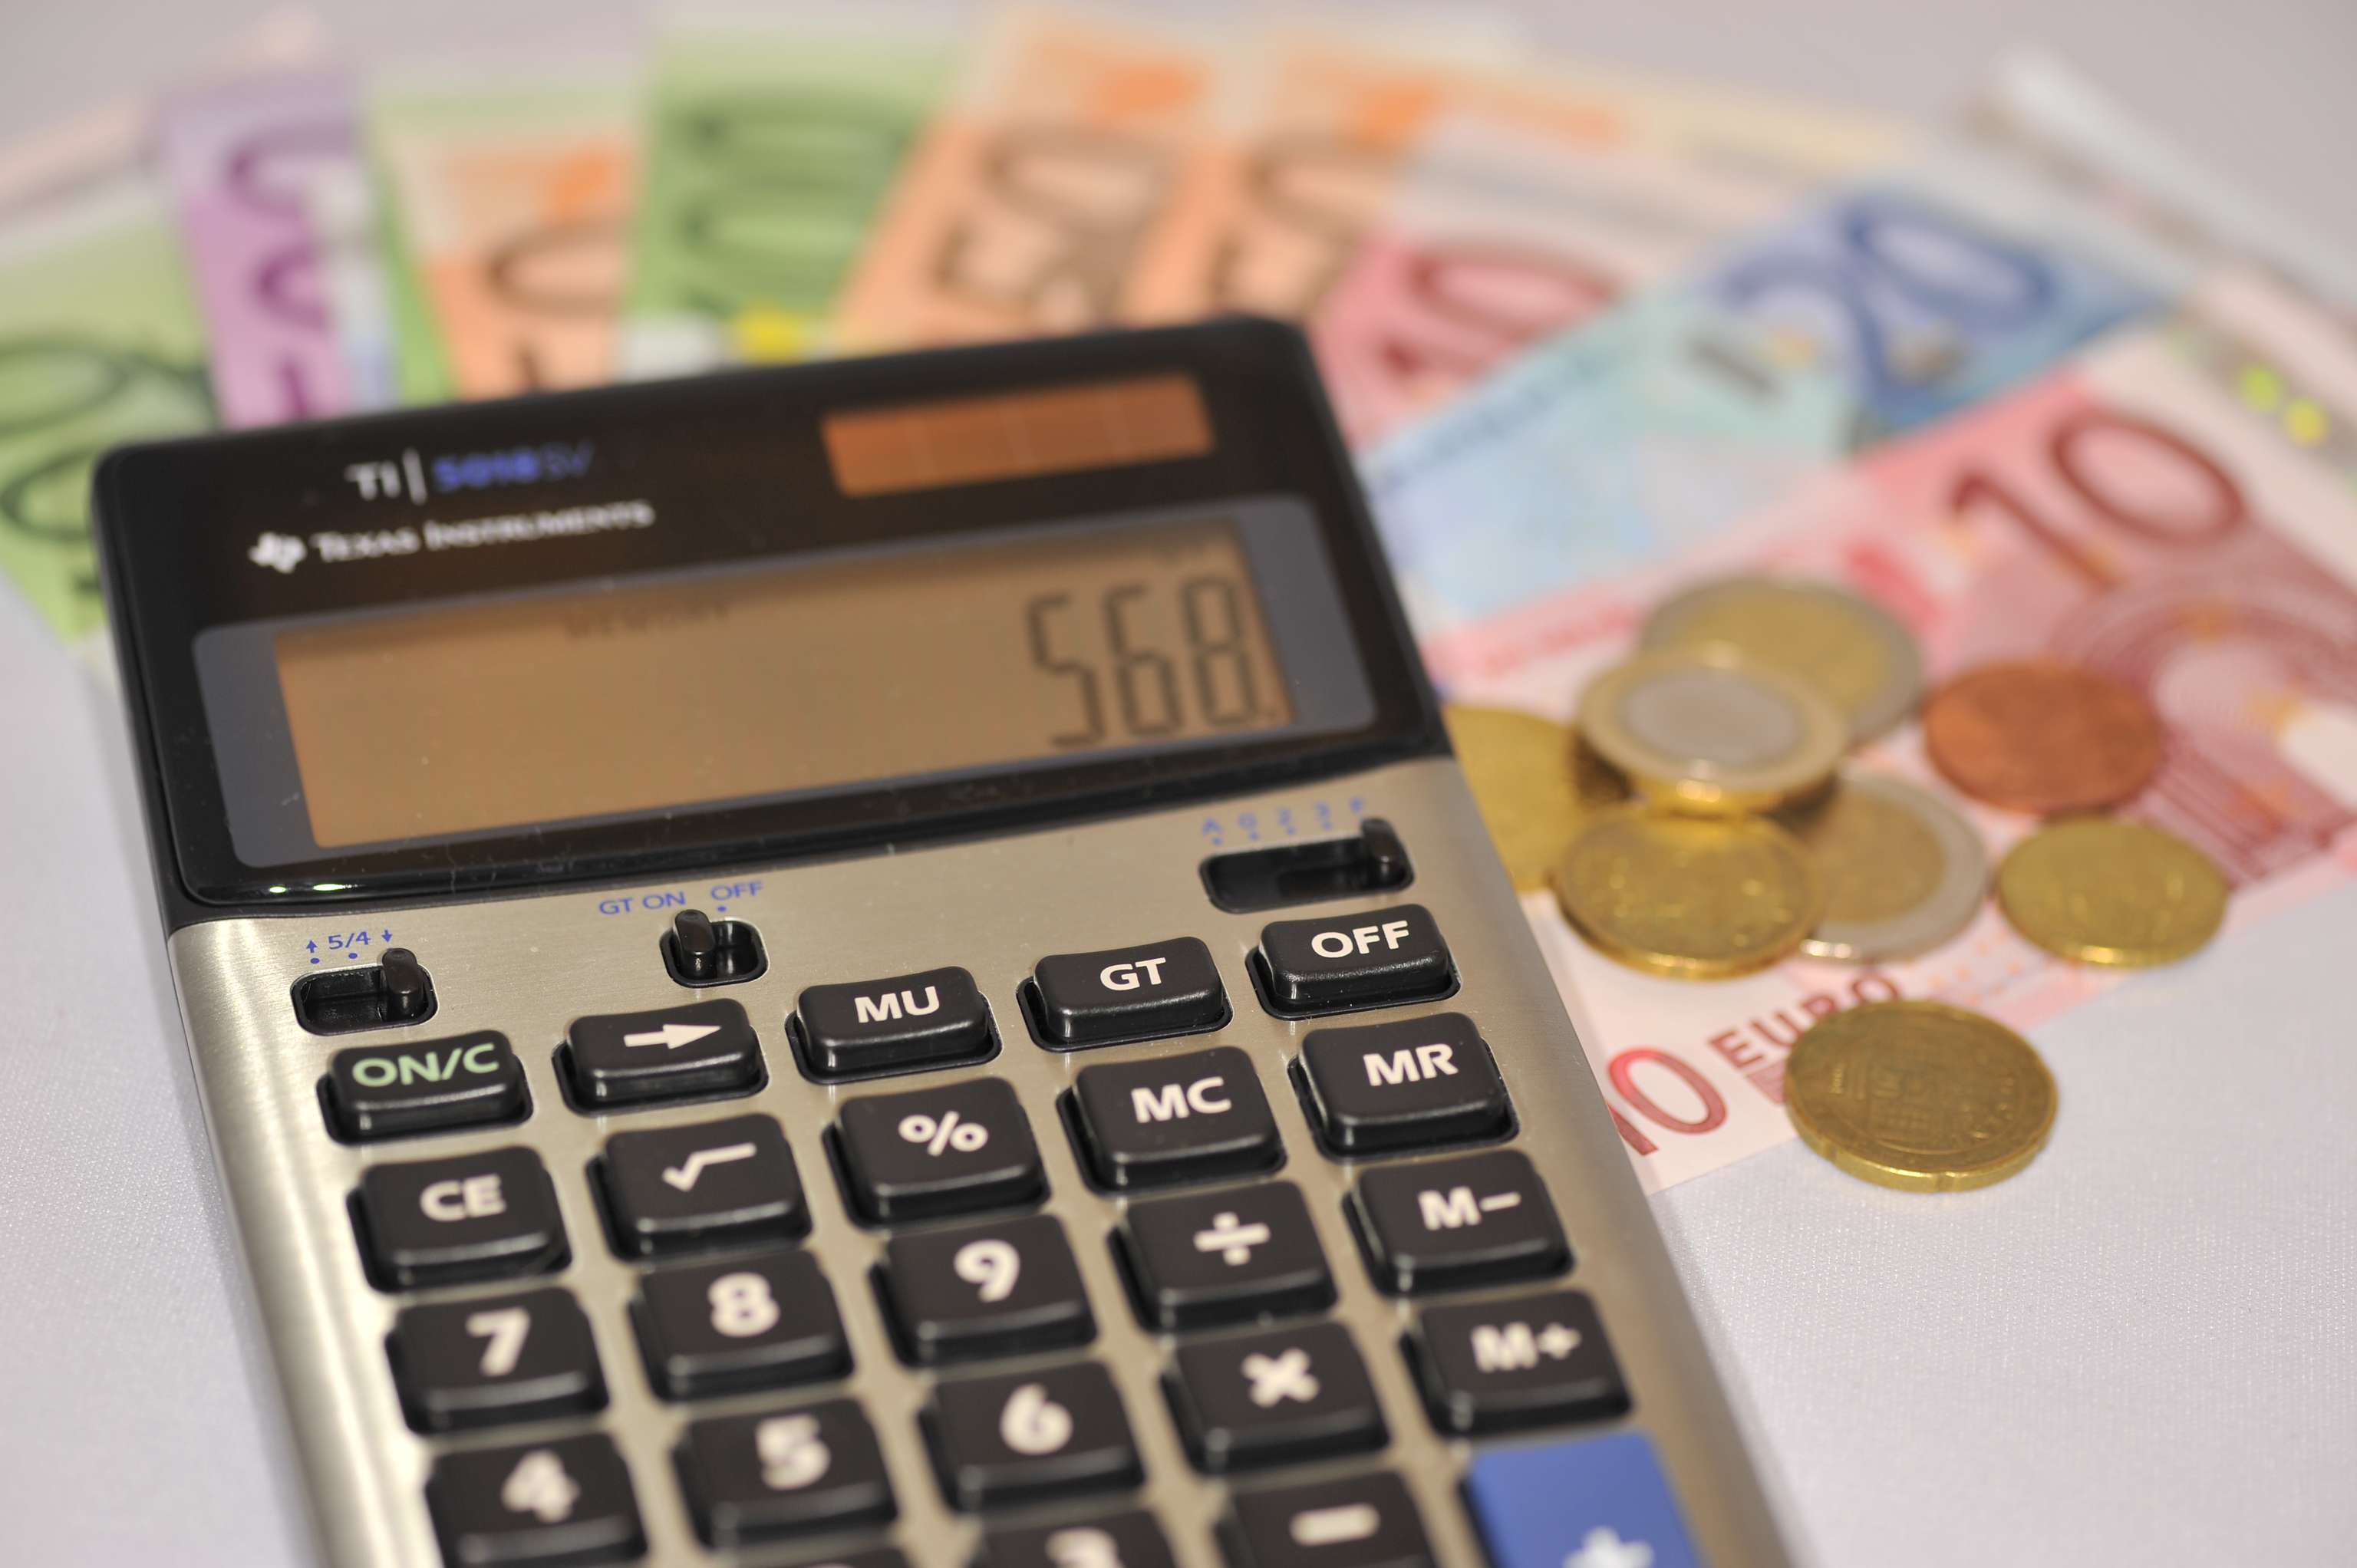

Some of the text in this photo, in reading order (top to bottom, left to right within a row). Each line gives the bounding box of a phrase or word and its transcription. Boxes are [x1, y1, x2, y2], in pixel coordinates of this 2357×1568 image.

[1945, 407, 2252, 591] 10
[598, 881, 766, 916] GT ON OFF
[328, 931, 372, 951] 5/4
[1310, 921, 1410, 958] OFF
[1099, 957, 1167, 991] GT
[855, 987, 941, 1023] MU
[352, 1043, 501, 1088] ON/C
[1363, 1043, 1459, 1086] MR
[1131, 1076, 1232, 1123] MC
[898, 1111, 990, 1156] %
[419, 1174, 507, 1222] CE
[953, 1240, 1020, 1303] 9
[707, 1271, 780, 1337] 8
[465, 1308, 531, 1376] 7
[1470, 1322, 1581, 1372] M+
[1000, 1384, 1073, 1454] 6
[754, 1413, 831, 1491] 5
[500, 1448, 581, 1524] 4
